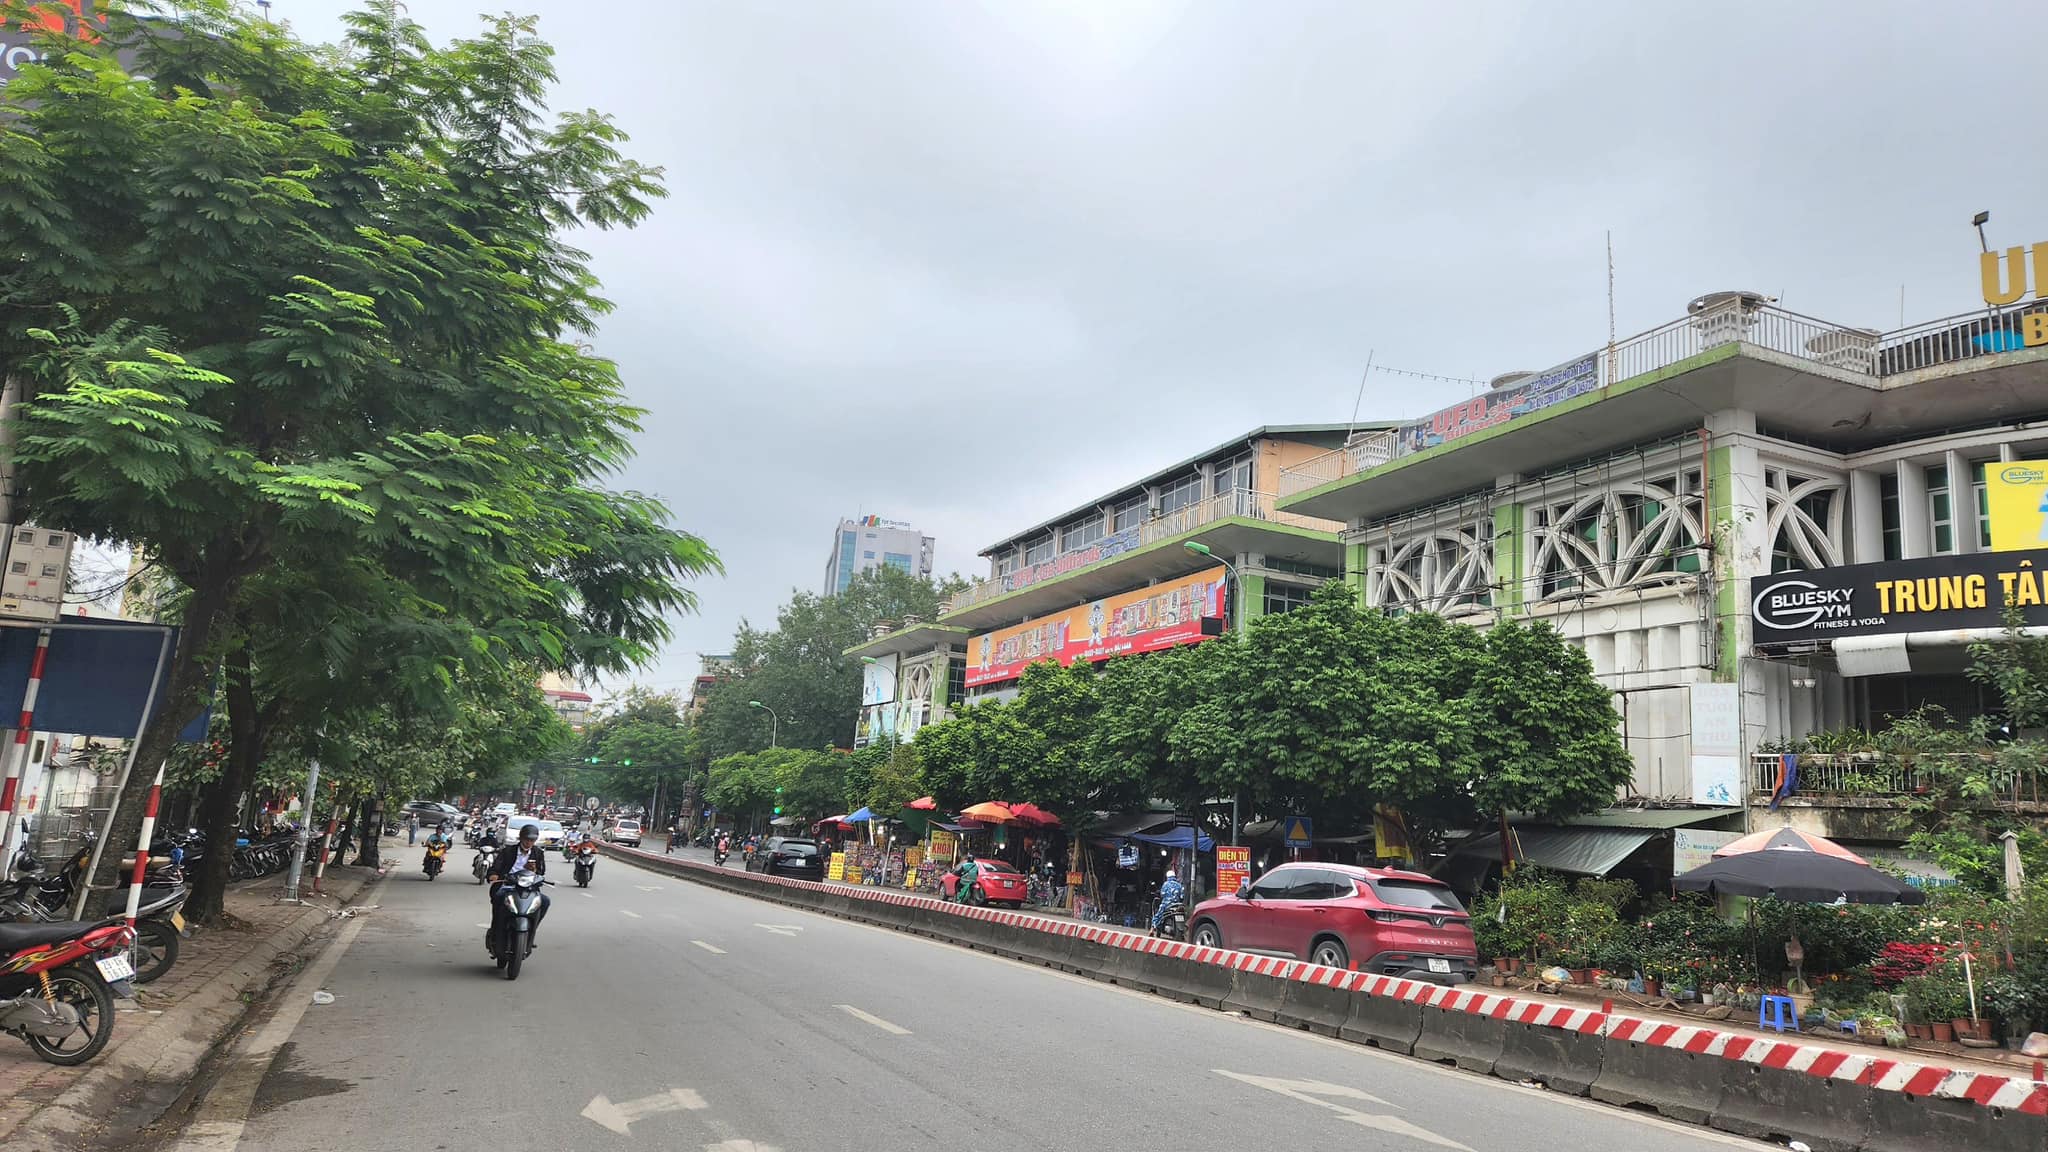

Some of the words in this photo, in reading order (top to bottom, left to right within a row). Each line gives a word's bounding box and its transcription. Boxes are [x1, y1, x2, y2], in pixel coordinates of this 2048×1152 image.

[1432, 397, 1488, 433] UFO
[1771, 588, 1854, 609] BLUESKY
[1876, 574, 1986, 615] TRUNG
[1997, 560, 2048, 606] TÂ
[1813, 619, 1849, 630] FITNESS
[1851, 618, 1857, 627] &
[1859, 616, 1886, 627] YOGA
